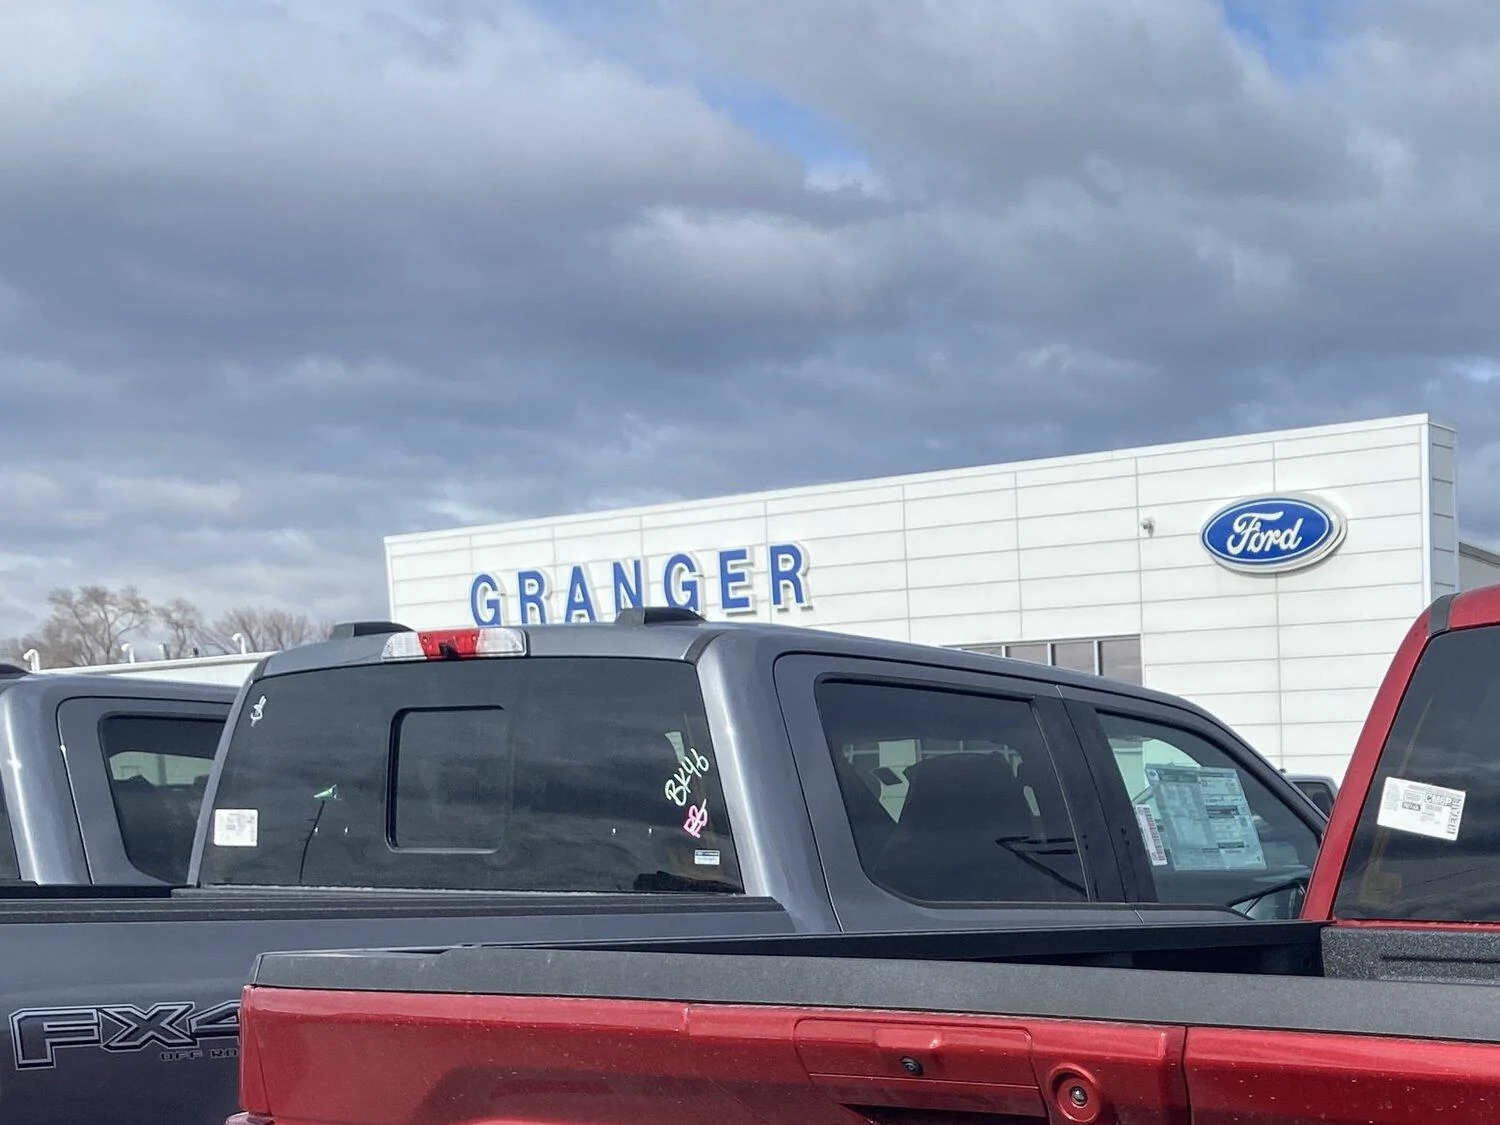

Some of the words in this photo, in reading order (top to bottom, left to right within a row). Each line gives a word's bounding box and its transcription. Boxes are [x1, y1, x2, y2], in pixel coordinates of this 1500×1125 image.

[1226, 510, 1304, 555] Ford
[470, 543, 806, 627] GRANGER
[9, 1000, 239, 1071] FX4
